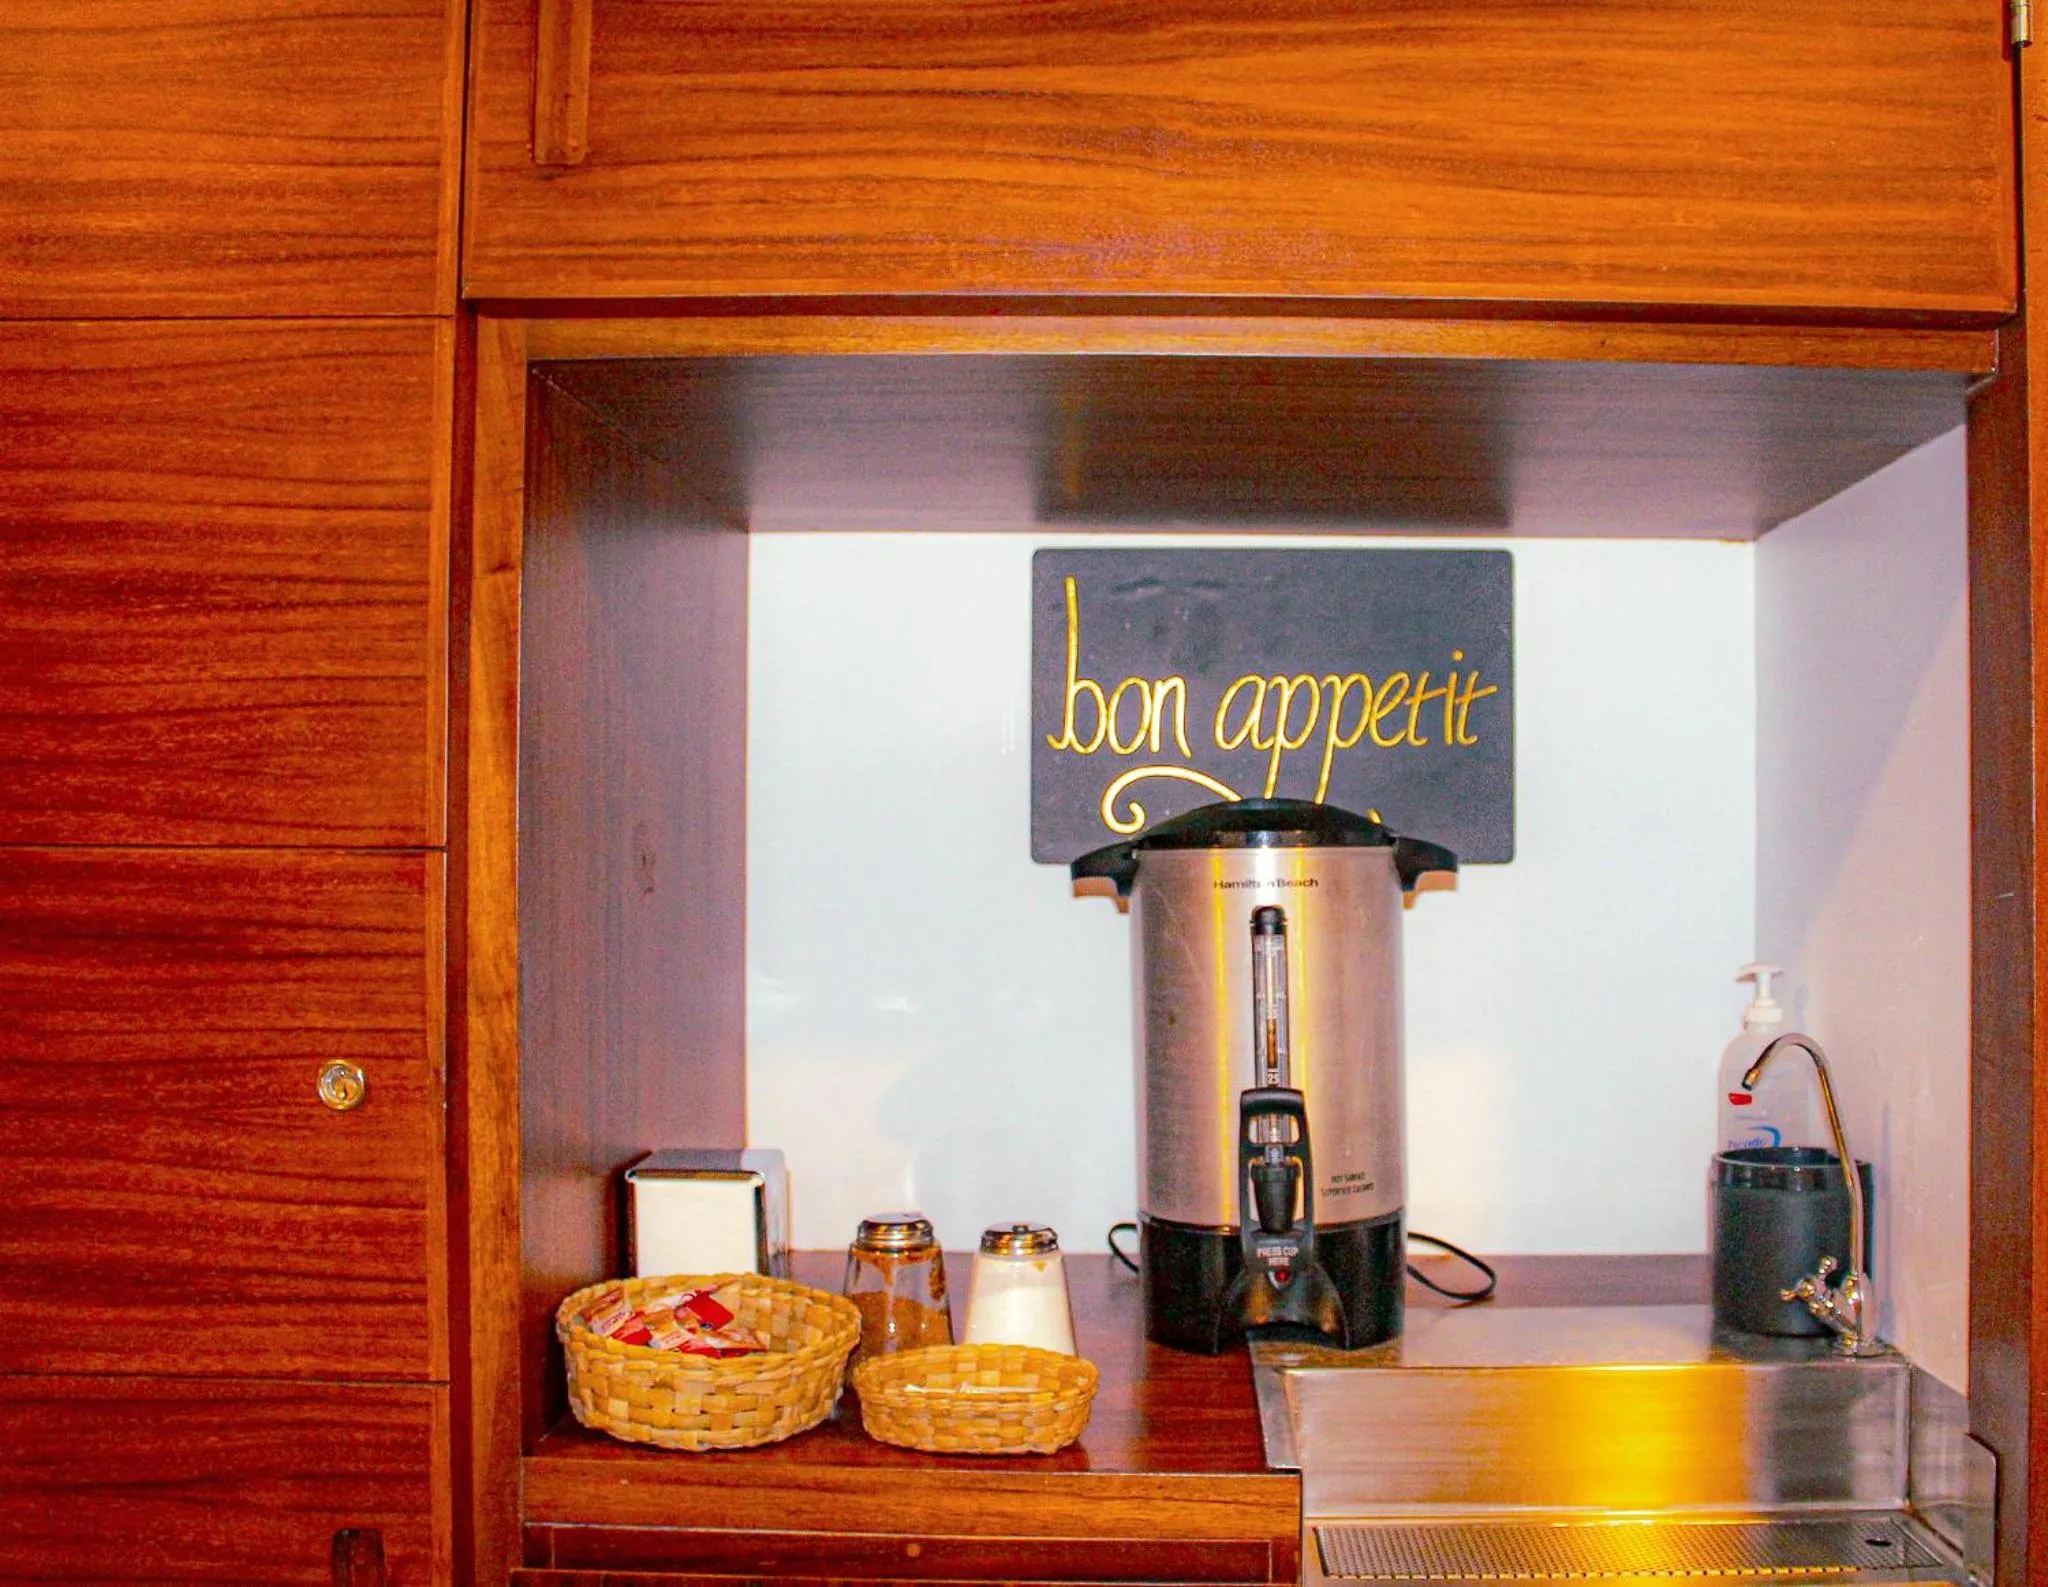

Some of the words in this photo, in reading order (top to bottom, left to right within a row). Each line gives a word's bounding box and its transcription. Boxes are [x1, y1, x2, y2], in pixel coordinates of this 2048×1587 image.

[1046, 575, 1192, 759] bon
[1213, 648, 1498, 805] appetit
[1276, 877, 1319, 889] Beach
[1283, 1246, 1299, 1257] CUP
